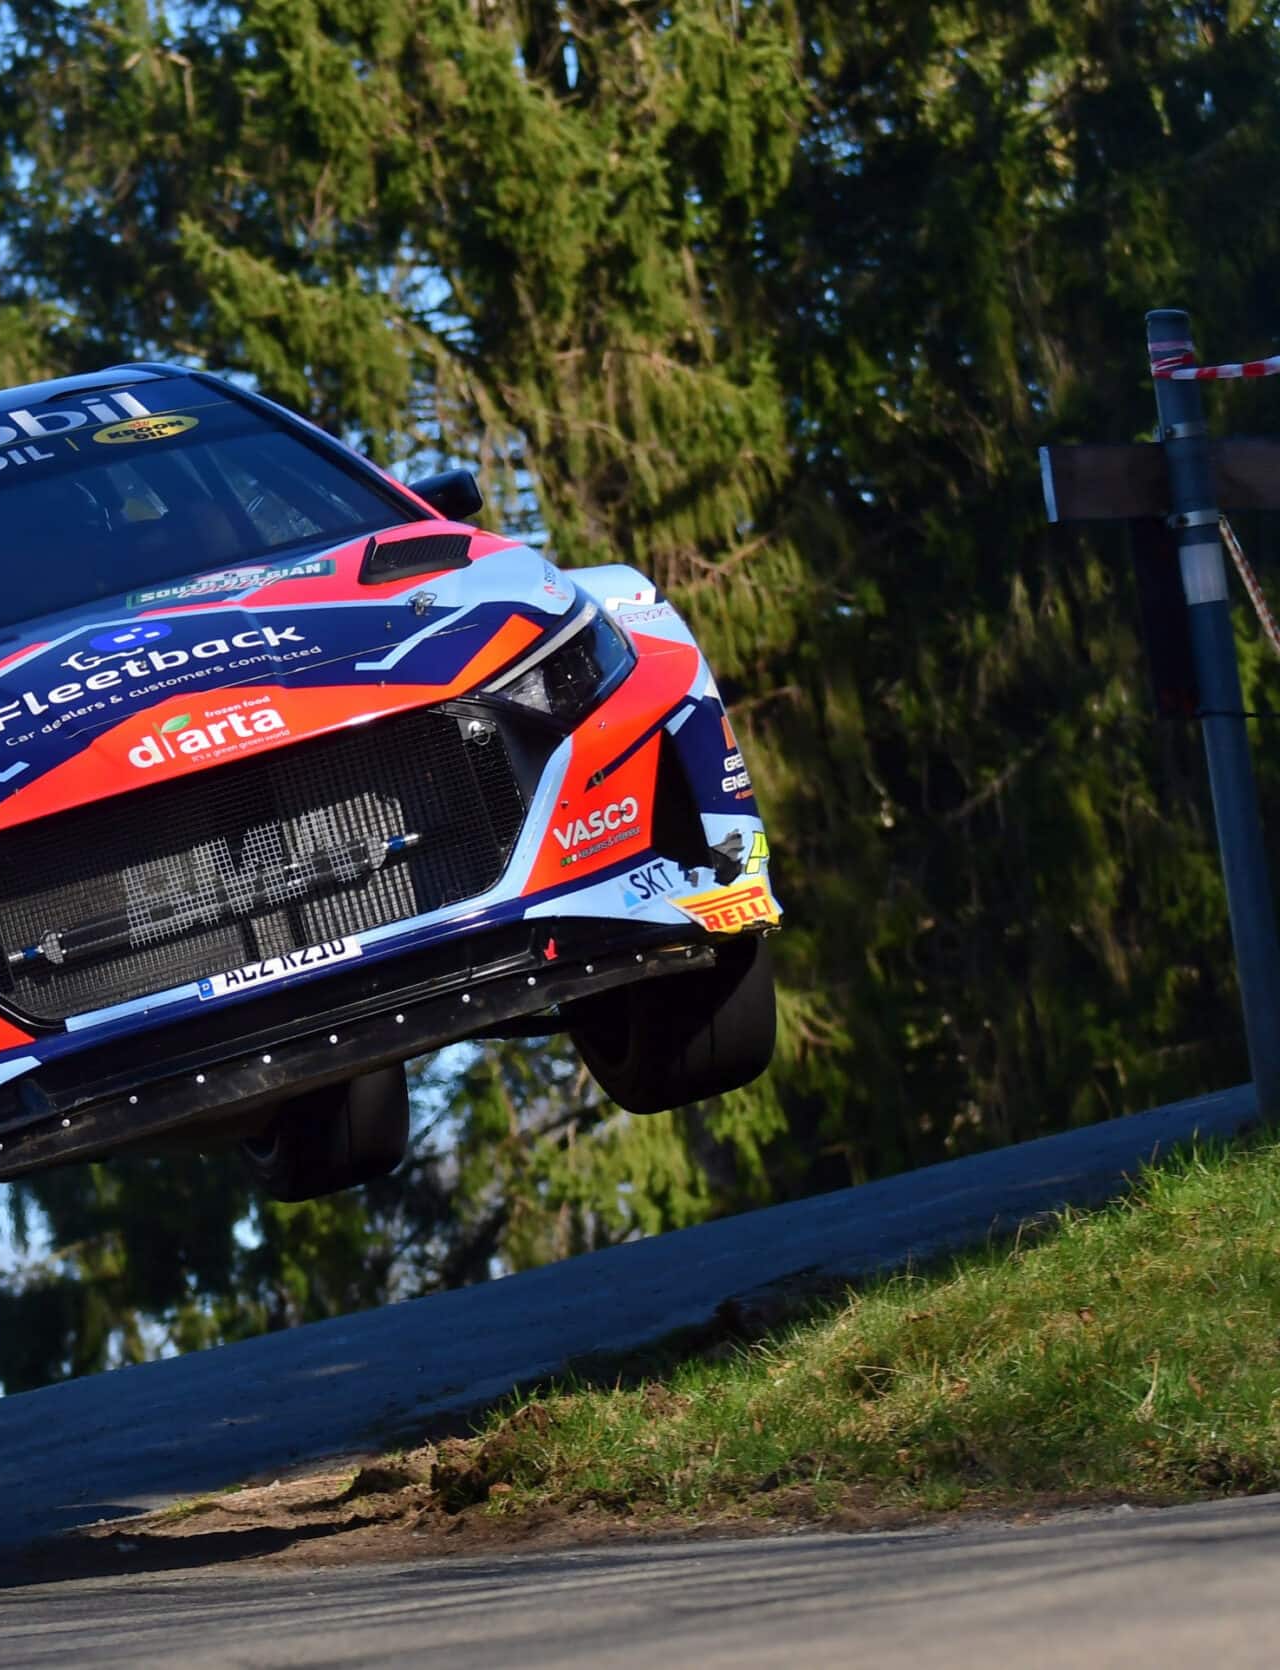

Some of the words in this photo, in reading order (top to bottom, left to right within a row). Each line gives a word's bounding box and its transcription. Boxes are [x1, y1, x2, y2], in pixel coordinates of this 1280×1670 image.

[107, 420, 184, 439] KROON
[134, 430, 169, 440] OIL
[6, 731, 37, 747] Car
[41, 701, 106, 734] dealers
[110, 694, 124, 704] &
[129, 665, 224, 697] customers
[229, 645, 322, 669] connected
[204, 704, 242, 718] frozen
[242, 695, 272, 708] food
[552, 796, 639, 850] VASCO
[629, 861, 674, 900] SKT
